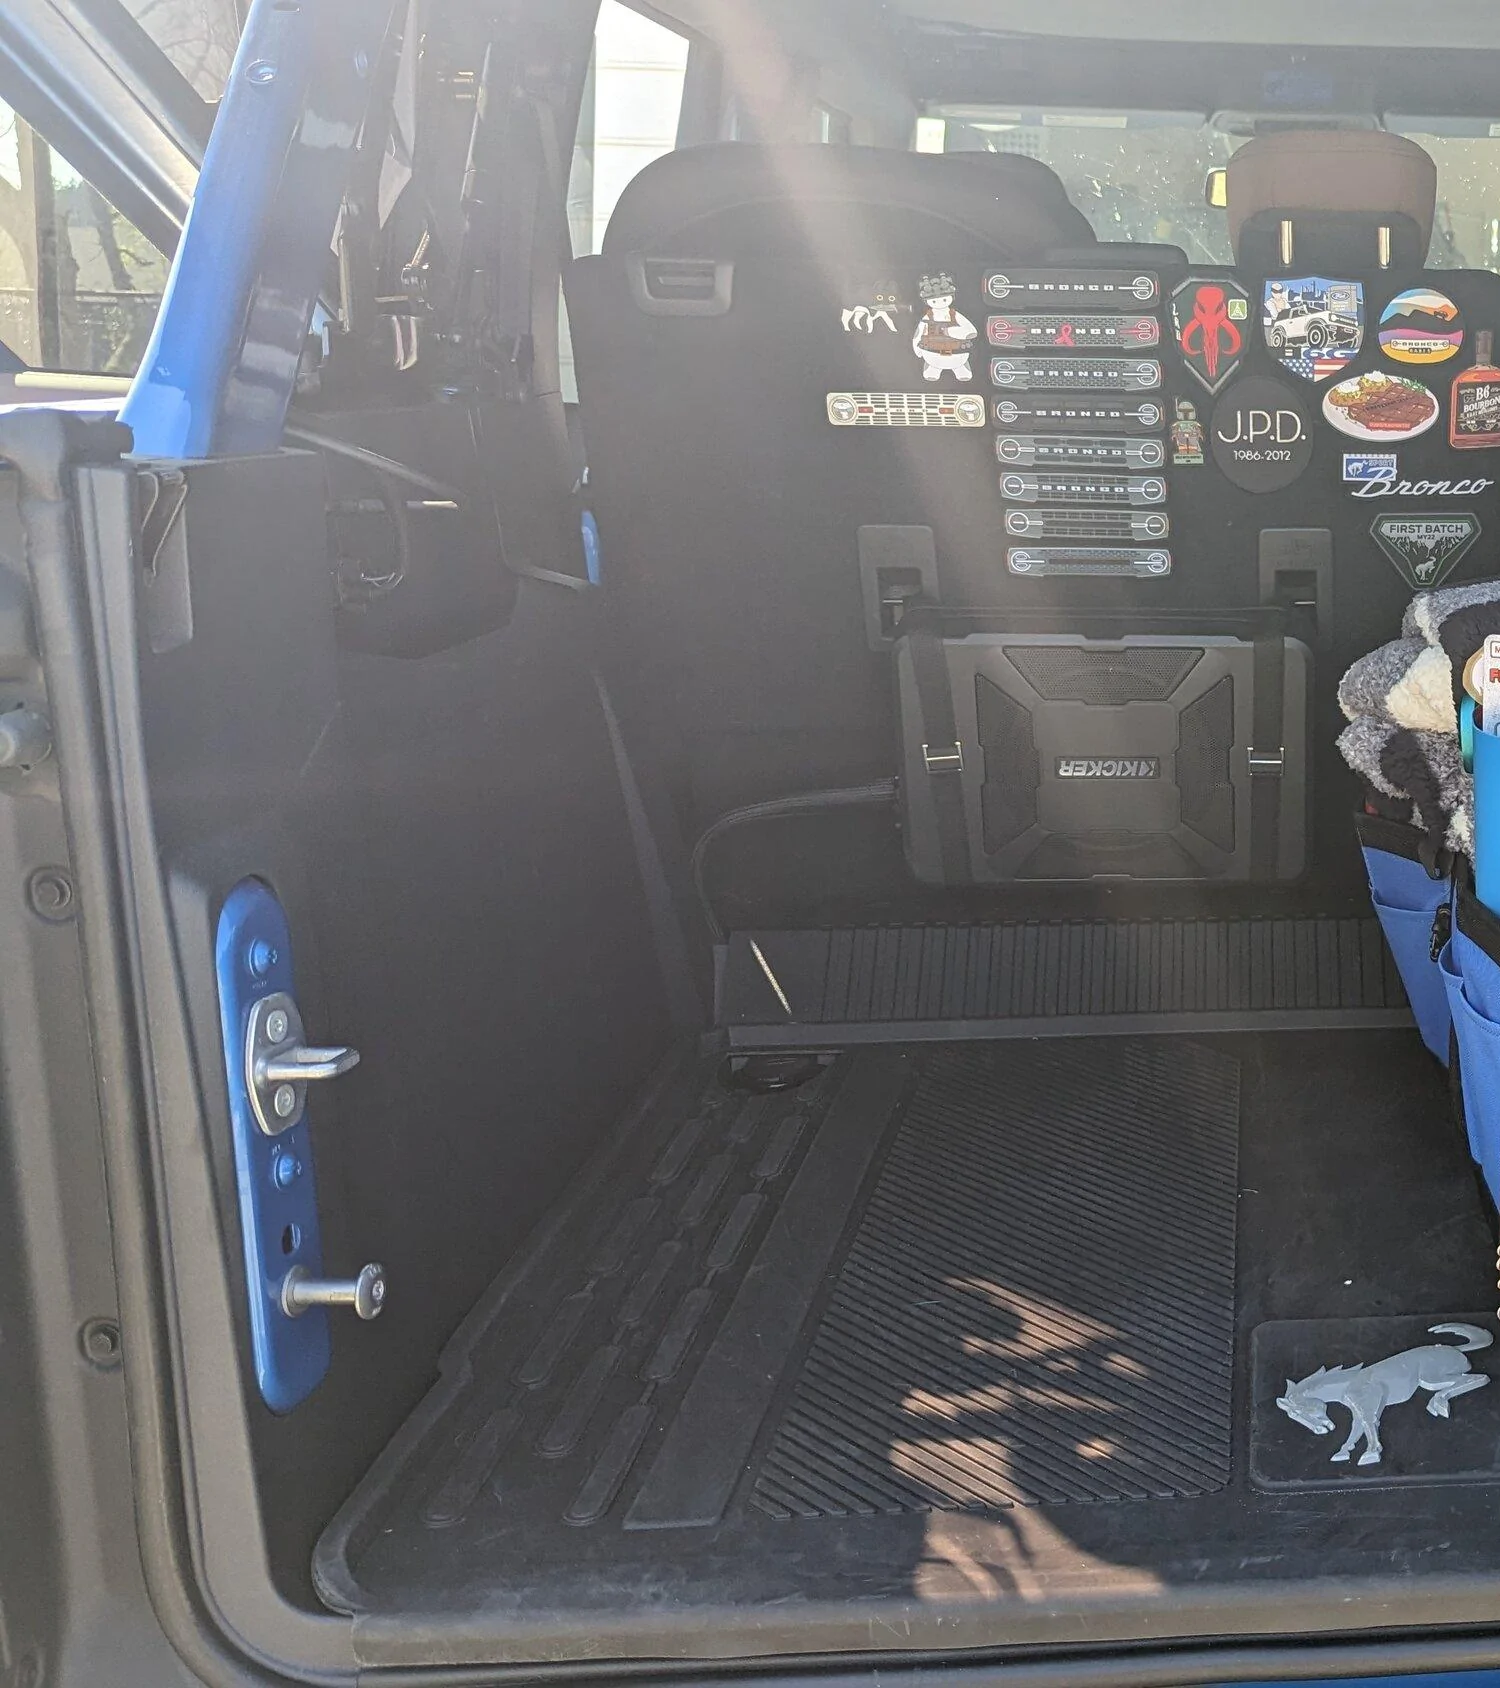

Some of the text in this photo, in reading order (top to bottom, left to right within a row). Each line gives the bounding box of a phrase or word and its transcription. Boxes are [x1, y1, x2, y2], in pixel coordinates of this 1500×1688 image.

[1028, 283, 1114, 292] BRONCO
[1030, 327, 1116, 336] BRNCO
[1033, 370, 1119, 378] BRONCO
[1036, 409, 1121, 418] BRONCO
[1217, 410, 1307, 443] J.P.D.
[1038, 447, 1122, 456] BRONCO
[1233, 450, 1292, 461] 1986-2012
[1351, 467, 1495, 498] Bronco
[1042, 484, 1125, 493] BRONCO
[1389, 524, 1464, 534] FIRST BATCH
[1058, 759, 1139, 777] KICKER
